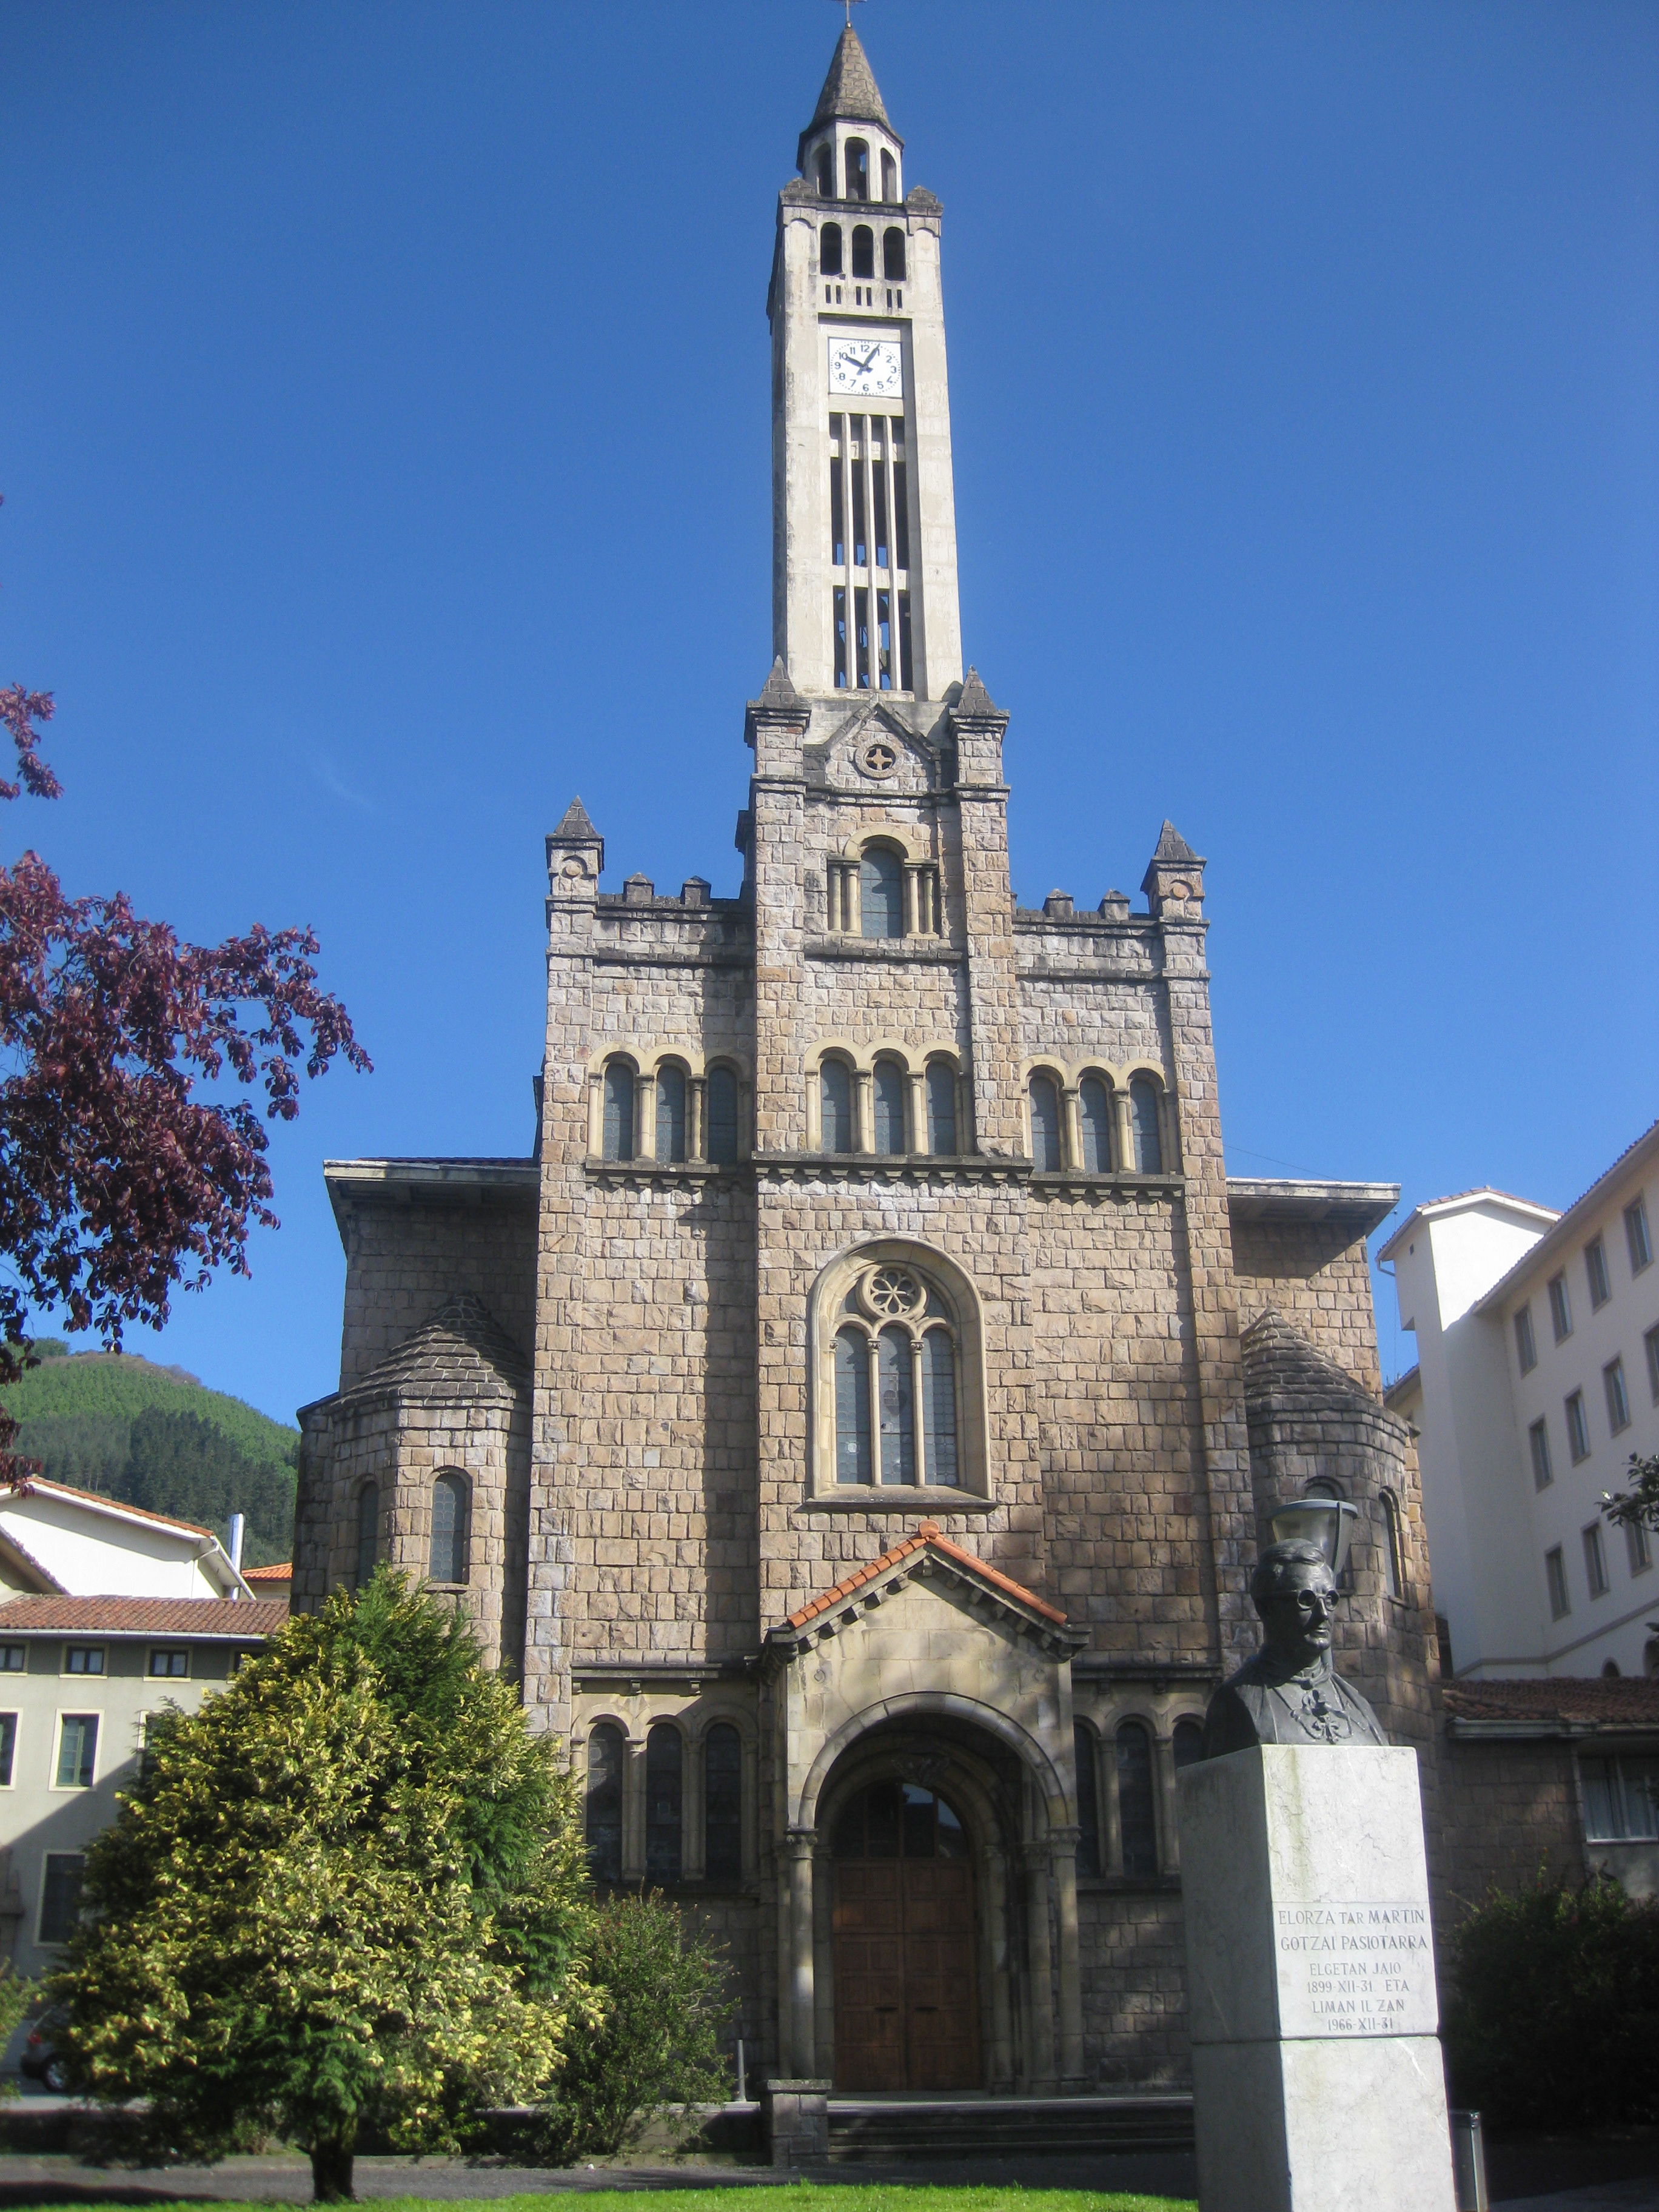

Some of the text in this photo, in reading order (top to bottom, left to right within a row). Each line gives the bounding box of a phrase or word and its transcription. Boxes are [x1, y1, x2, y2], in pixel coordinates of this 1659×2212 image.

[850, 379, 856, 387] 7
[877, 381, 883, 389] 5
[1279, 1909, 1425, 1925] ELORZA TAR MARTIN
[1281, 1935, 1428, 1951] GOTZAI PASIOTARRA
[1373, 1962, 1401, 1975] JAIO
[1386, 1979, 1410, 1992] ETA
[1312, 1999, 1405, 2014] LIMAN IL ZAN
[1328, 2017, 1393, 2031] 1966-XII-31
